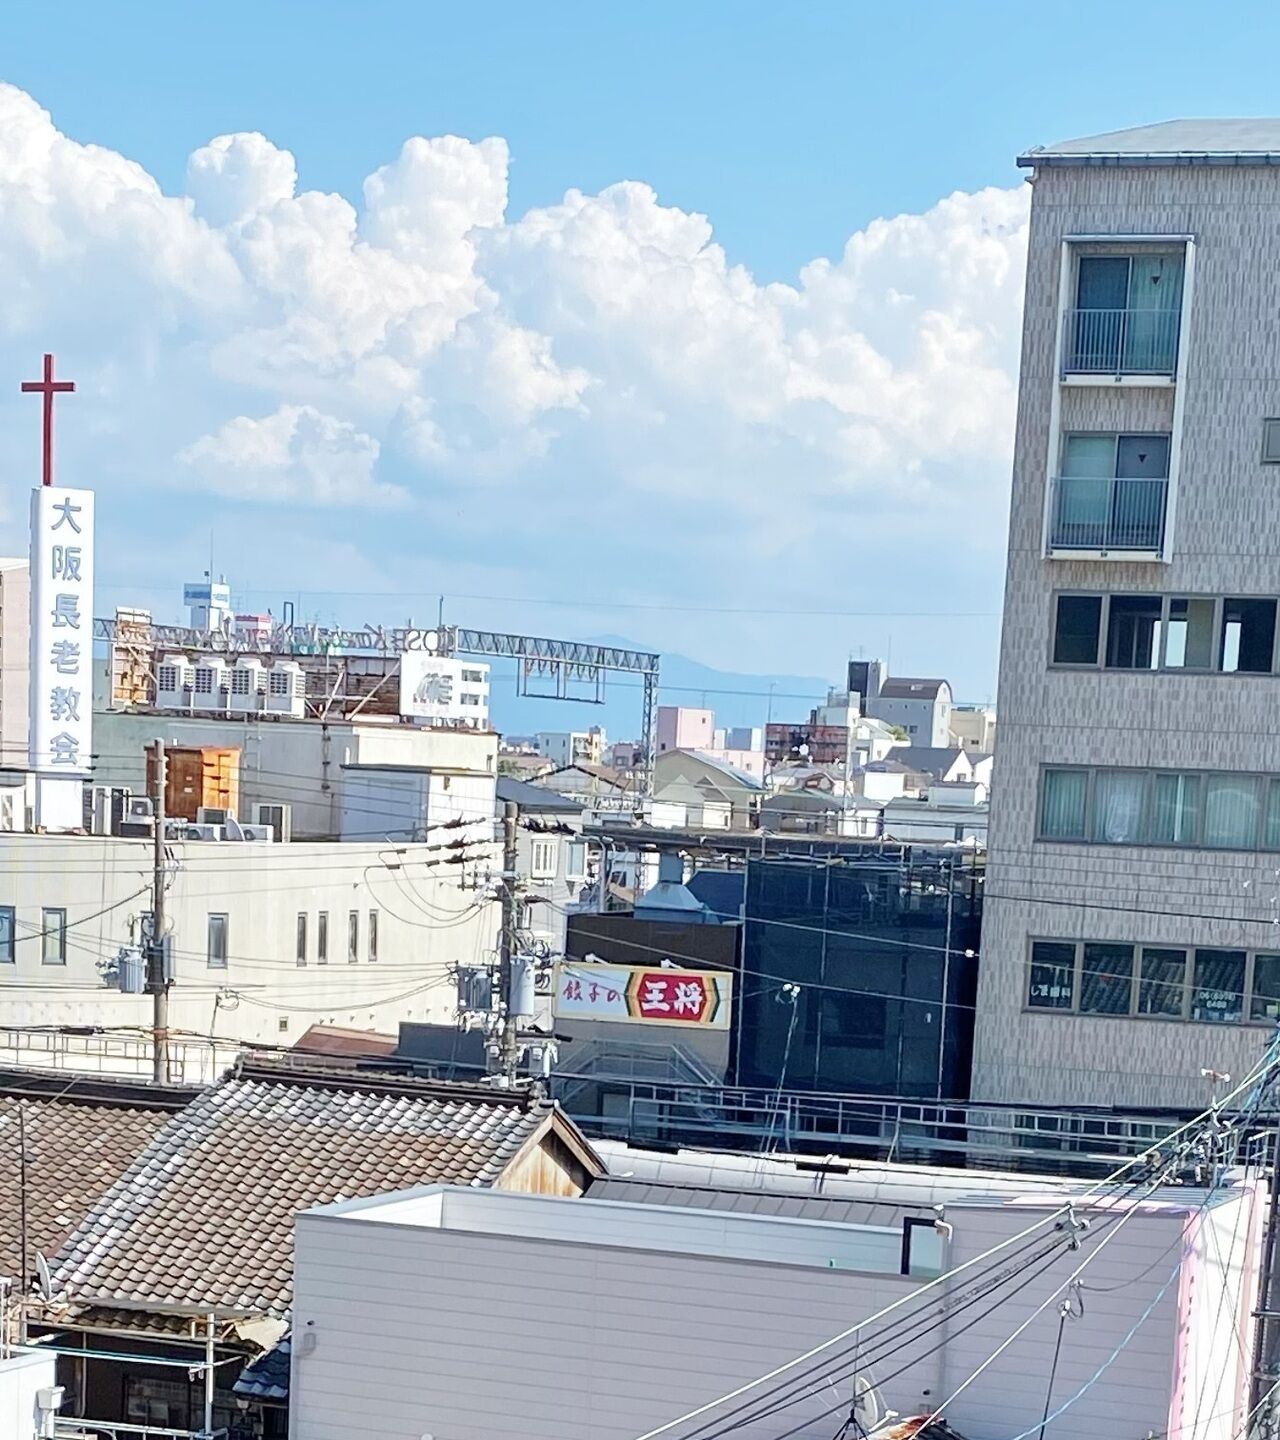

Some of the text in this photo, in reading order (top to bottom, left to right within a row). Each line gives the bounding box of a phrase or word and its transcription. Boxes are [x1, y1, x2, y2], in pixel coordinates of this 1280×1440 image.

[51, 497, 81, 764] 大阪長老教会
[563, 979, 704, 1015] 餃子の王将
